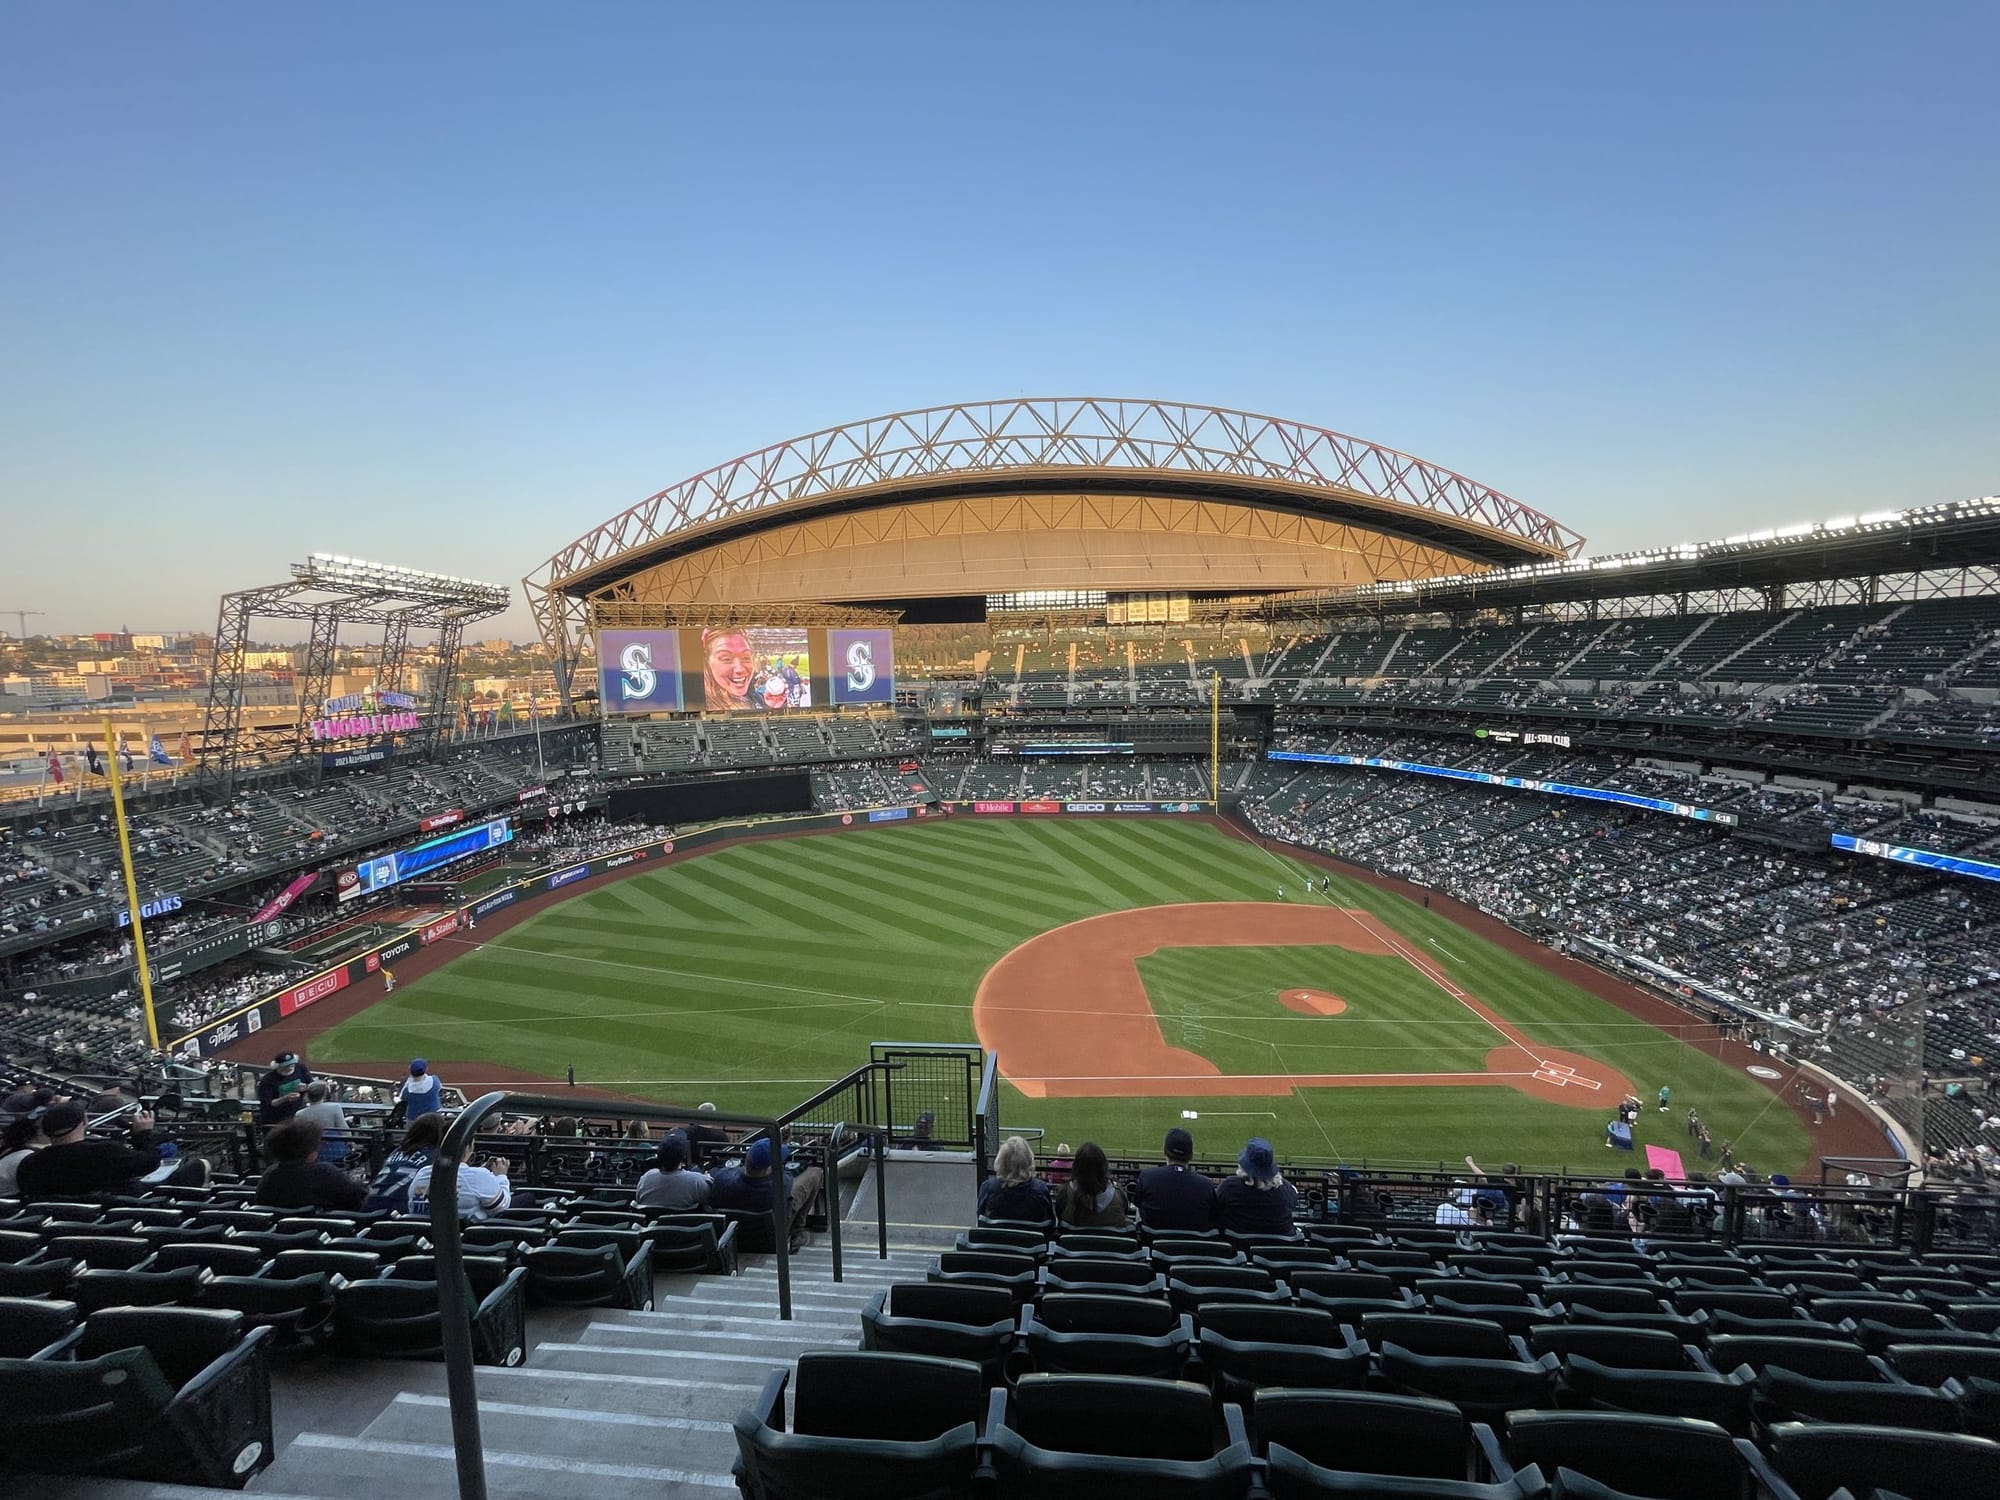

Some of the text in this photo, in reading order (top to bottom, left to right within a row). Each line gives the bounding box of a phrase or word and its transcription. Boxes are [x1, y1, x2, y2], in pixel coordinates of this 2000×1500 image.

[313, 711, 419, 740] T-MOBILE PARK
[1553, 735, 1571, 748] CLUB
[1066, 803, 1105, 812] GEICO
[607, 855, 634, 867] KeyBank
[436, 922, 451, 935] State
[381, 942, 410, 961] TOYOTA
[298, 977, 334, 1003] BECU
